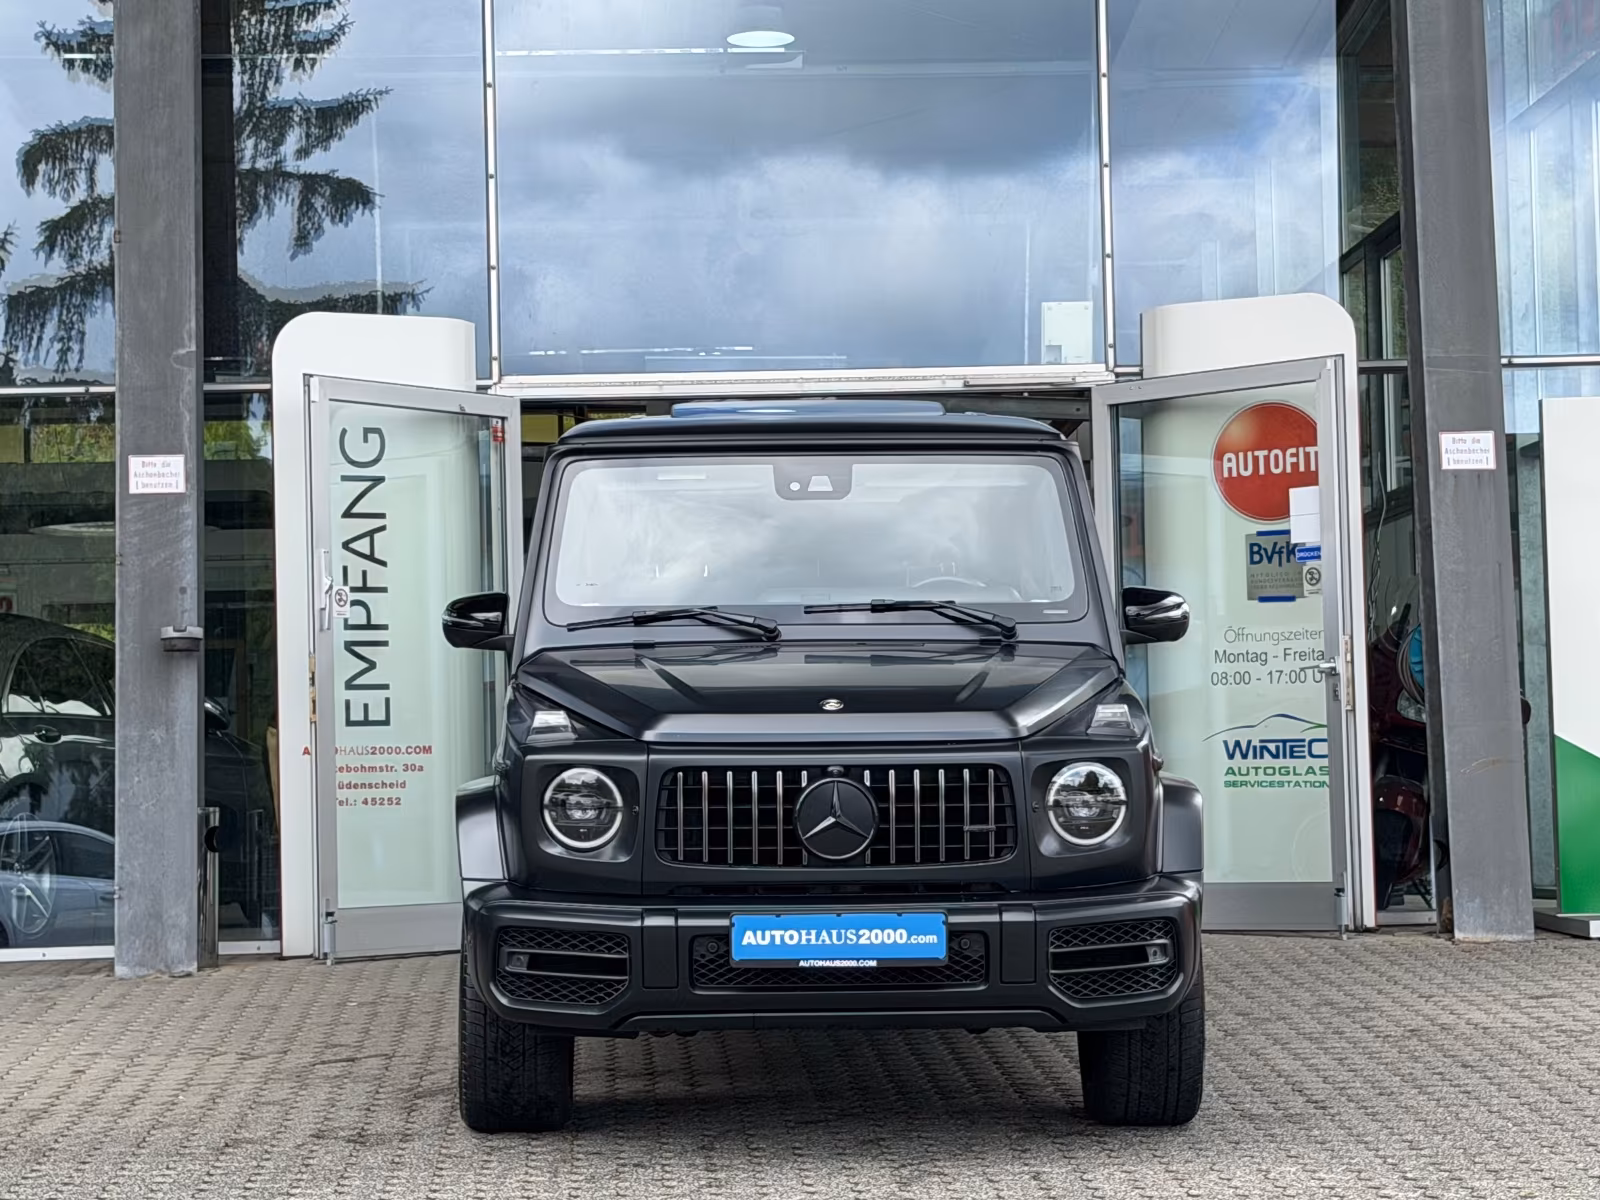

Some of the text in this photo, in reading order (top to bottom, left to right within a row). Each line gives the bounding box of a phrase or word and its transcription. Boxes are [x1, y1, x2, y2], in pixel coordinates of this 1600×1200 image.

[1222, 446, 1319, 478] AUTOFIT
[338, 426, 391, 727] EMPFANG
[1214, 649, 1268, 666] Montag
[1283, 647, 1325, 662] Freita
[1210, 670, 1252, 686] 08:00
[1267, 669, 1307, 685] 17:00
[334, 763, 424, 773] ebohmstr. 30a
[1224, 766, 1330, 777] AUTOGLAS
[336, 780, 407, 790] üdenscheid
[1223, 780, 1330, 788] SERVICESTATION
[335, 797, 402, 807] el.: 45252
[741, 929, 938, 945] AUTOHAUS2000.com
[799, 959, 877, 967] AUTOHAUS2000.COM
